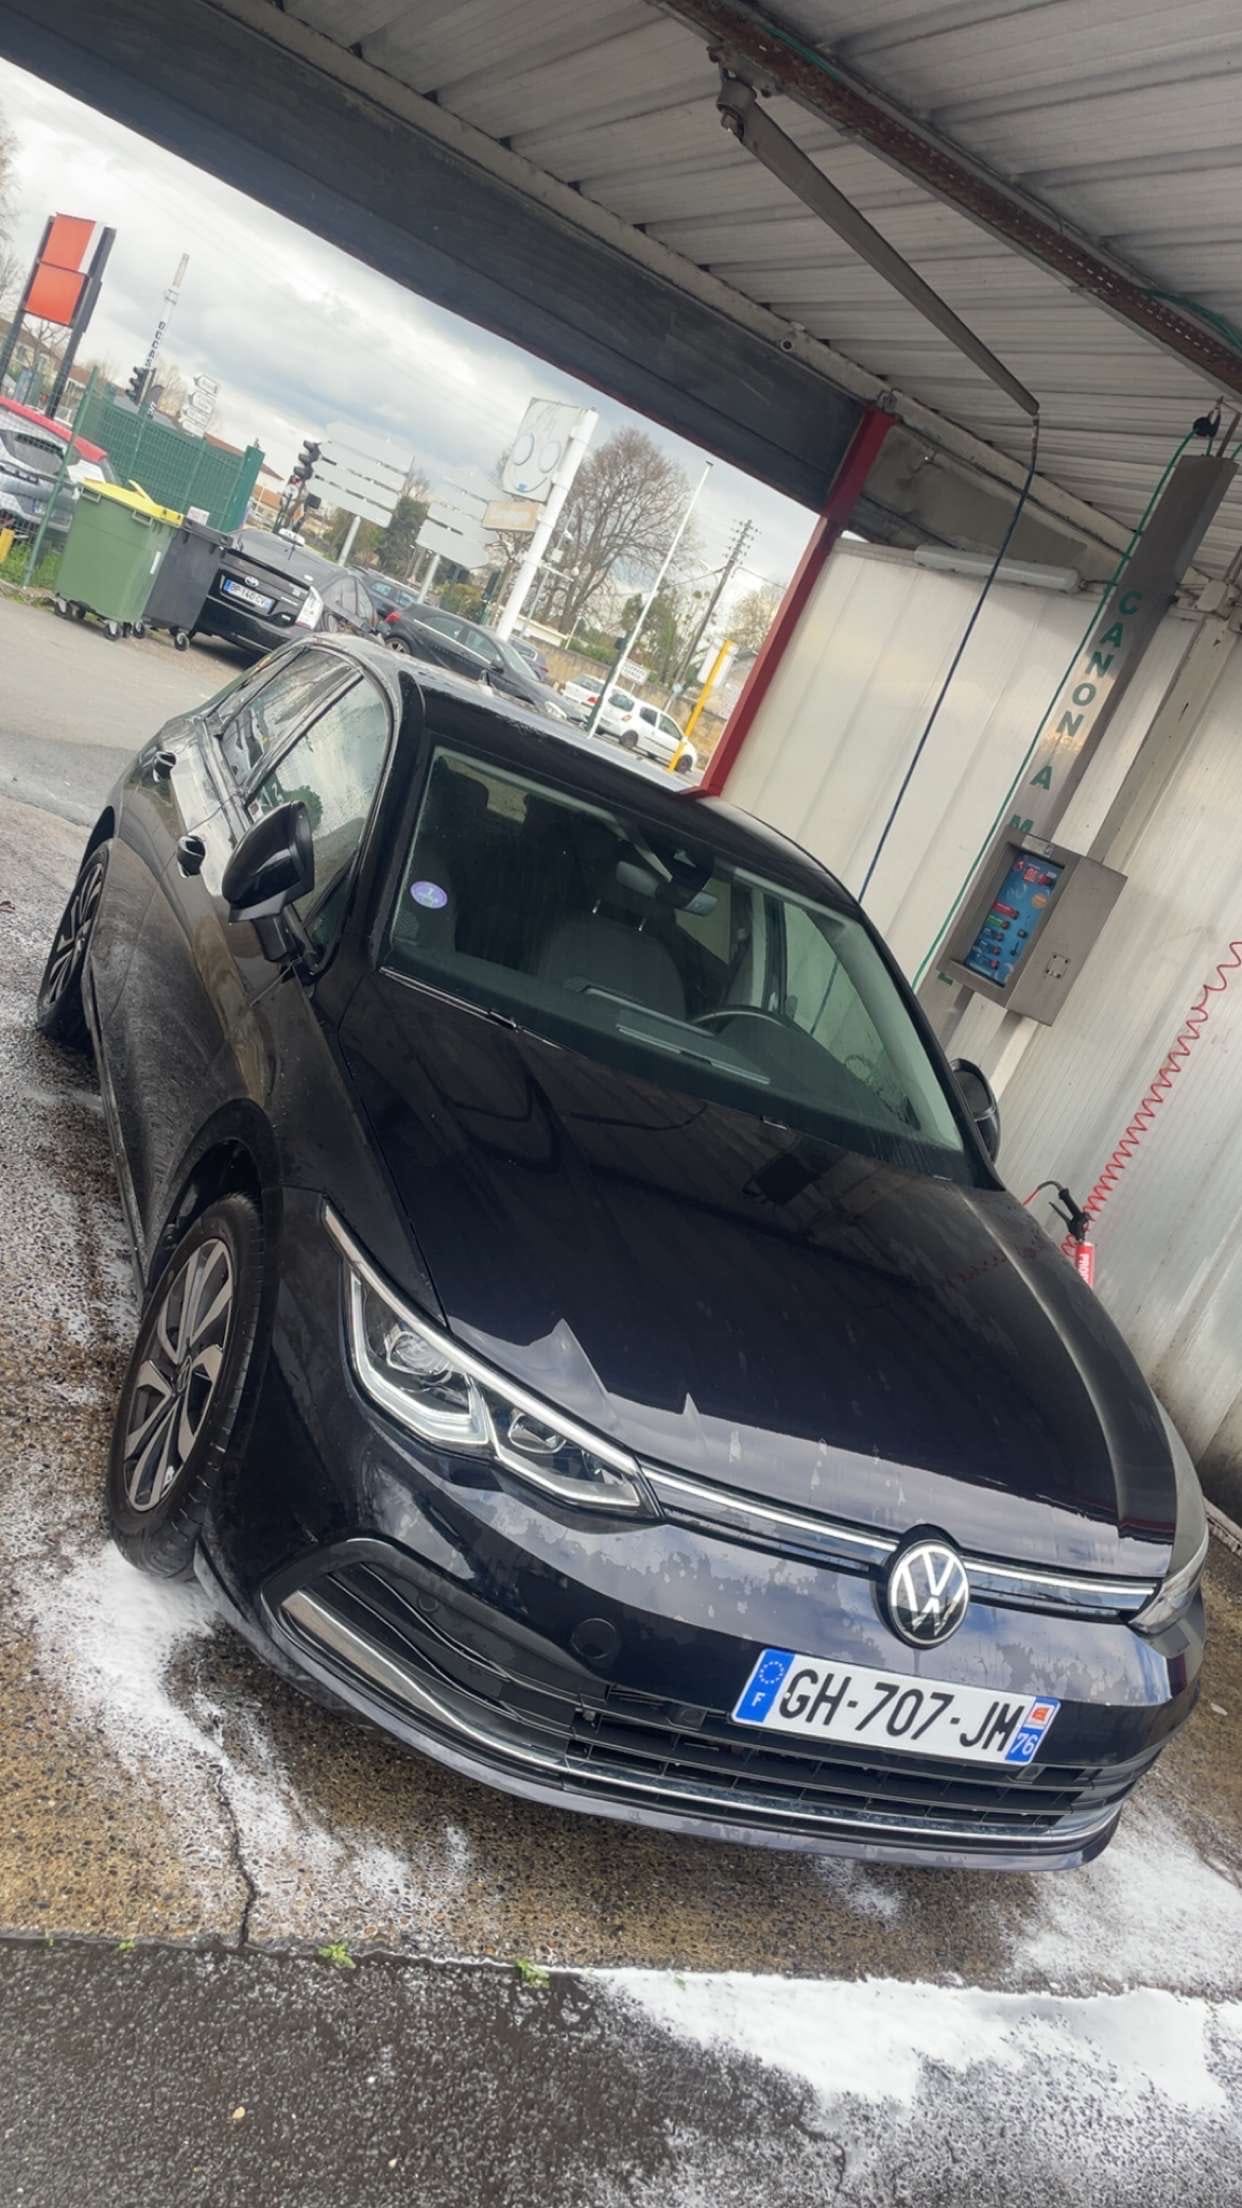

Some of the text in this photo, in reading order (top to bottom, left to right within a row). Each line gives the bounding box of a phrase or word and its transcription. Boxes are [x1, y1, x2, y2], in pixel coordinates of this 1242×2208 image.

[1030, 591, 1142, 790] CANON A
[751, 1669, 1025, 1752] F GH-707-JM
[1010, 1732, 1038, 1756] 76
